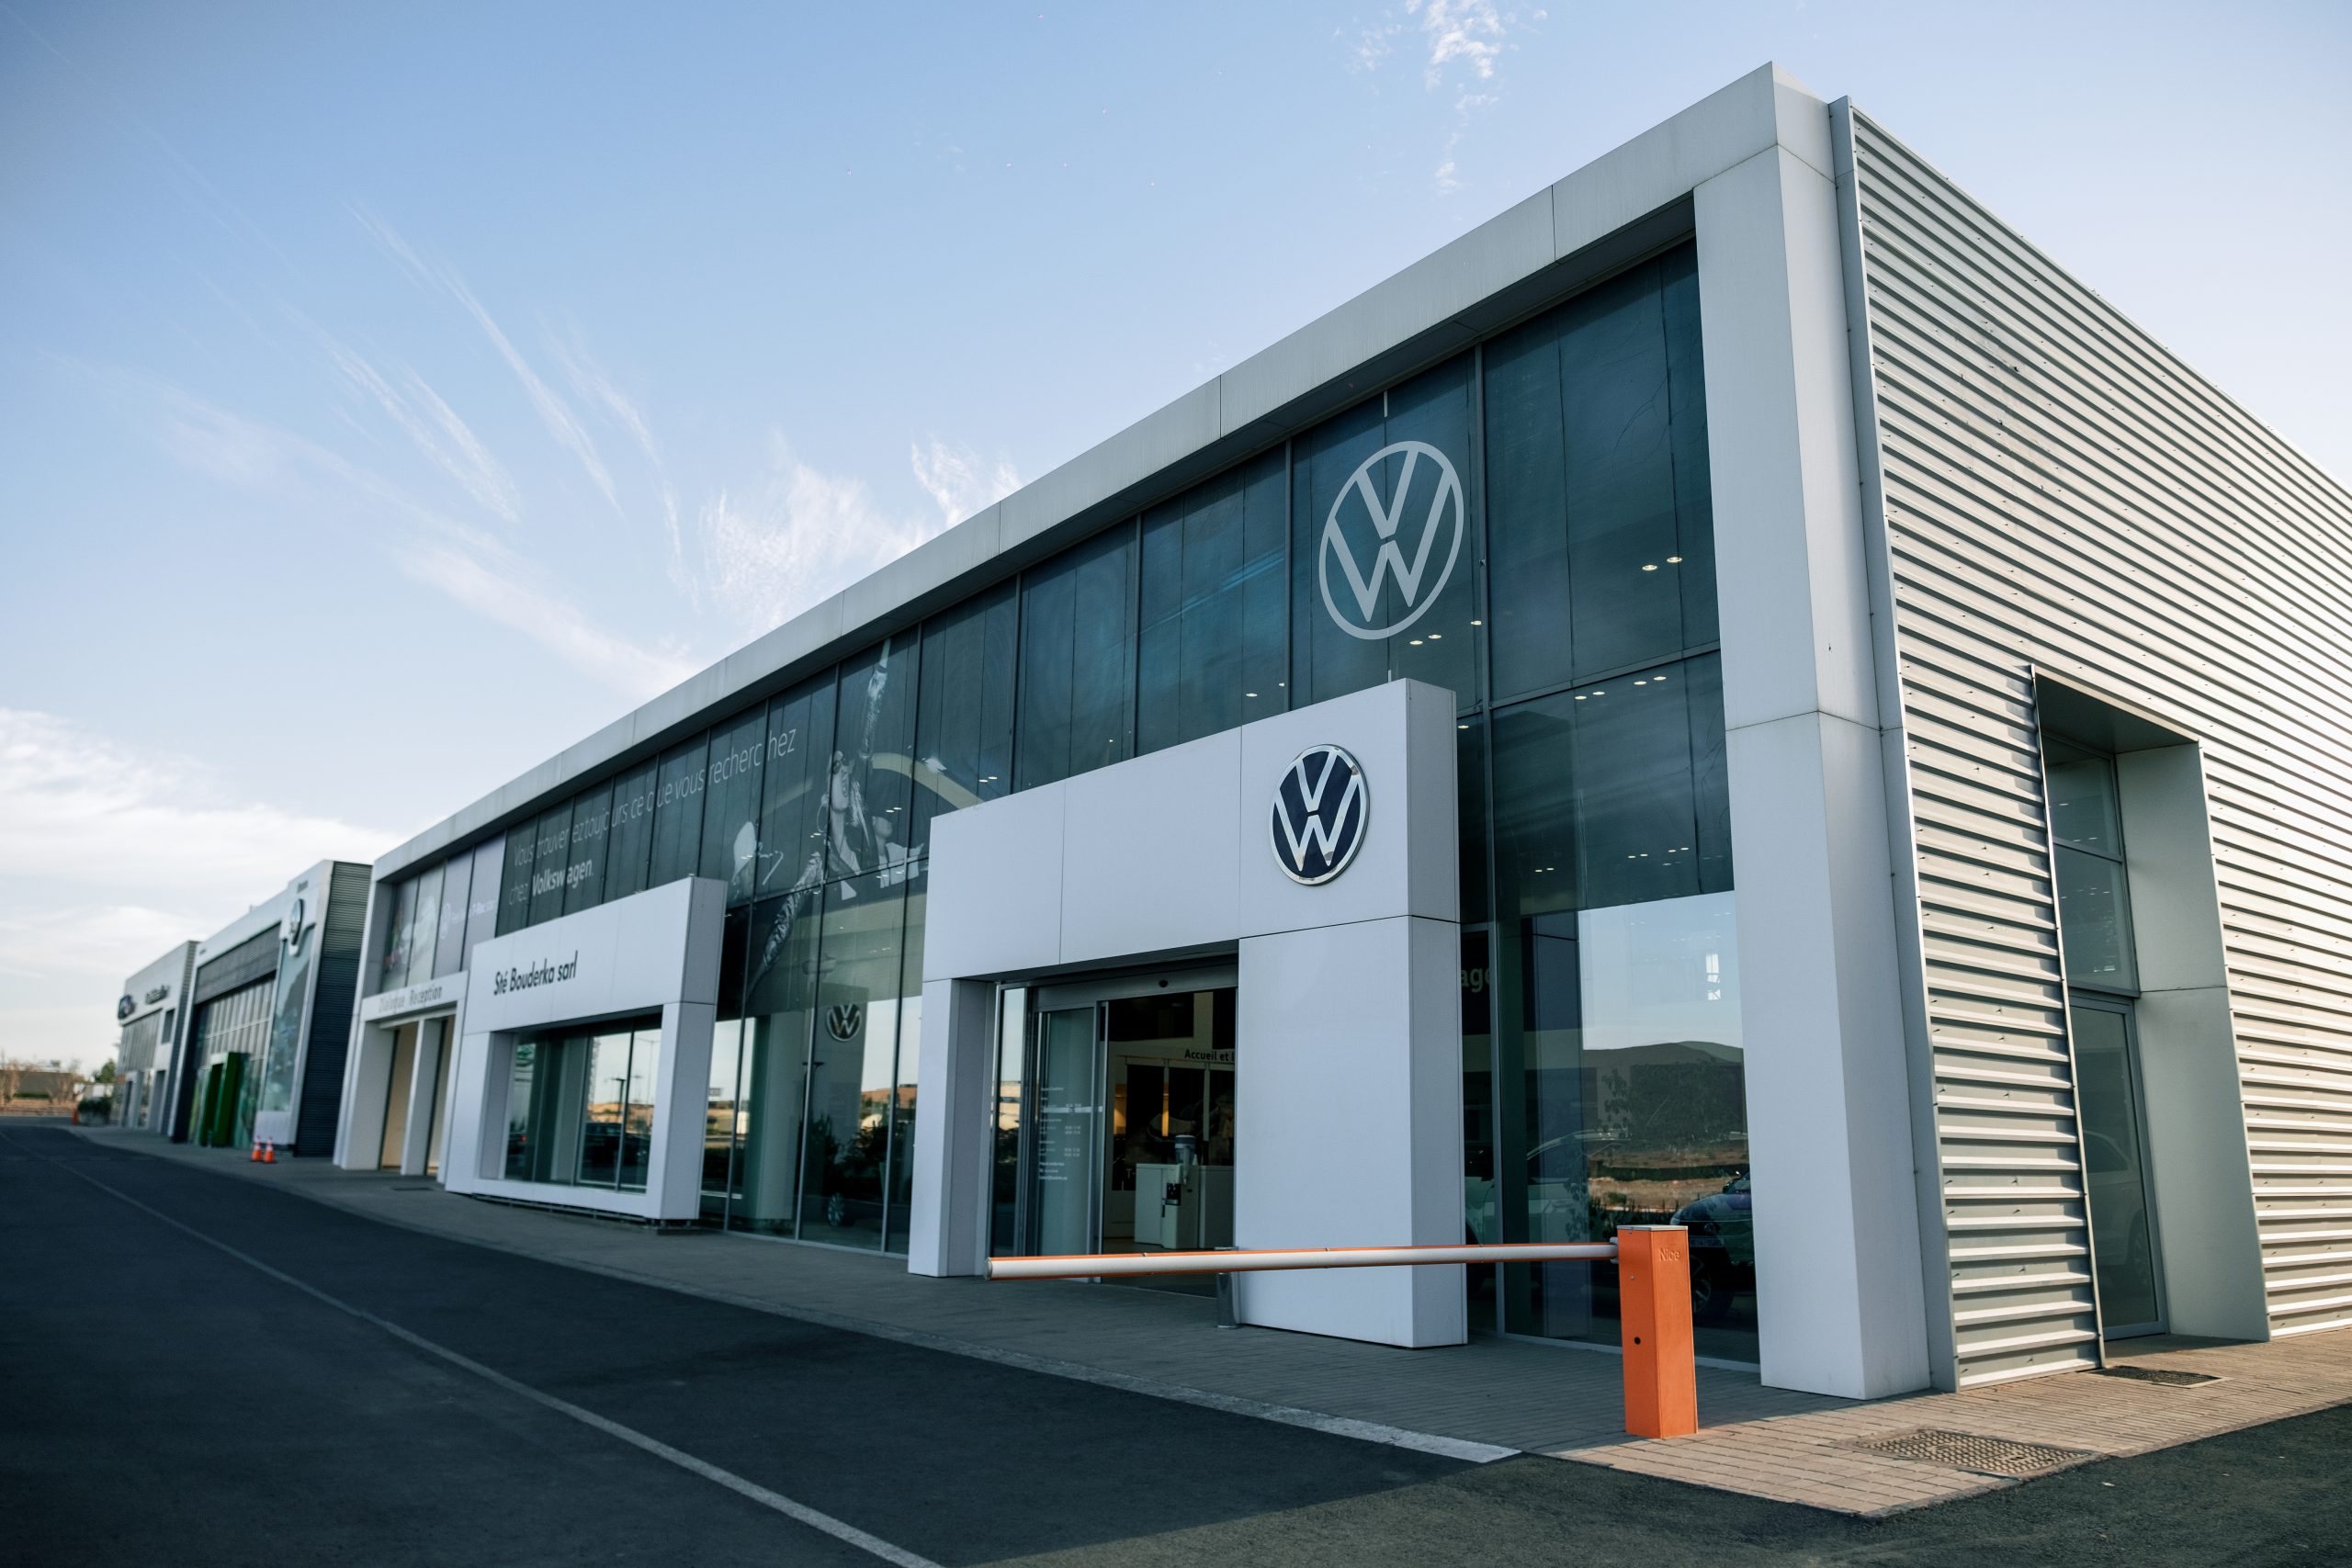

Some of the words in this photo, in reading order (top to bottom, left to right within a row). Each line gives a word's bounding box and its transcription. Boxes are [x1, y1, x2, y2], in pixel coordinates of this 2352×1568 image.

[1325, 444, 1458, 626] VW
[630, 795, 644, 818] ce
[675, 769, 705, 800] vous
[1272, 746, 1363, 874] VW
[509, 958, 555, 992] Bouderka
[557, 950, 578, 982] sarl
[1184, 1048, 1217, 1061] Accueil
[1219, 1052, 1229, 1062] et
[1659, 1247, 1680, 1262] Nice
